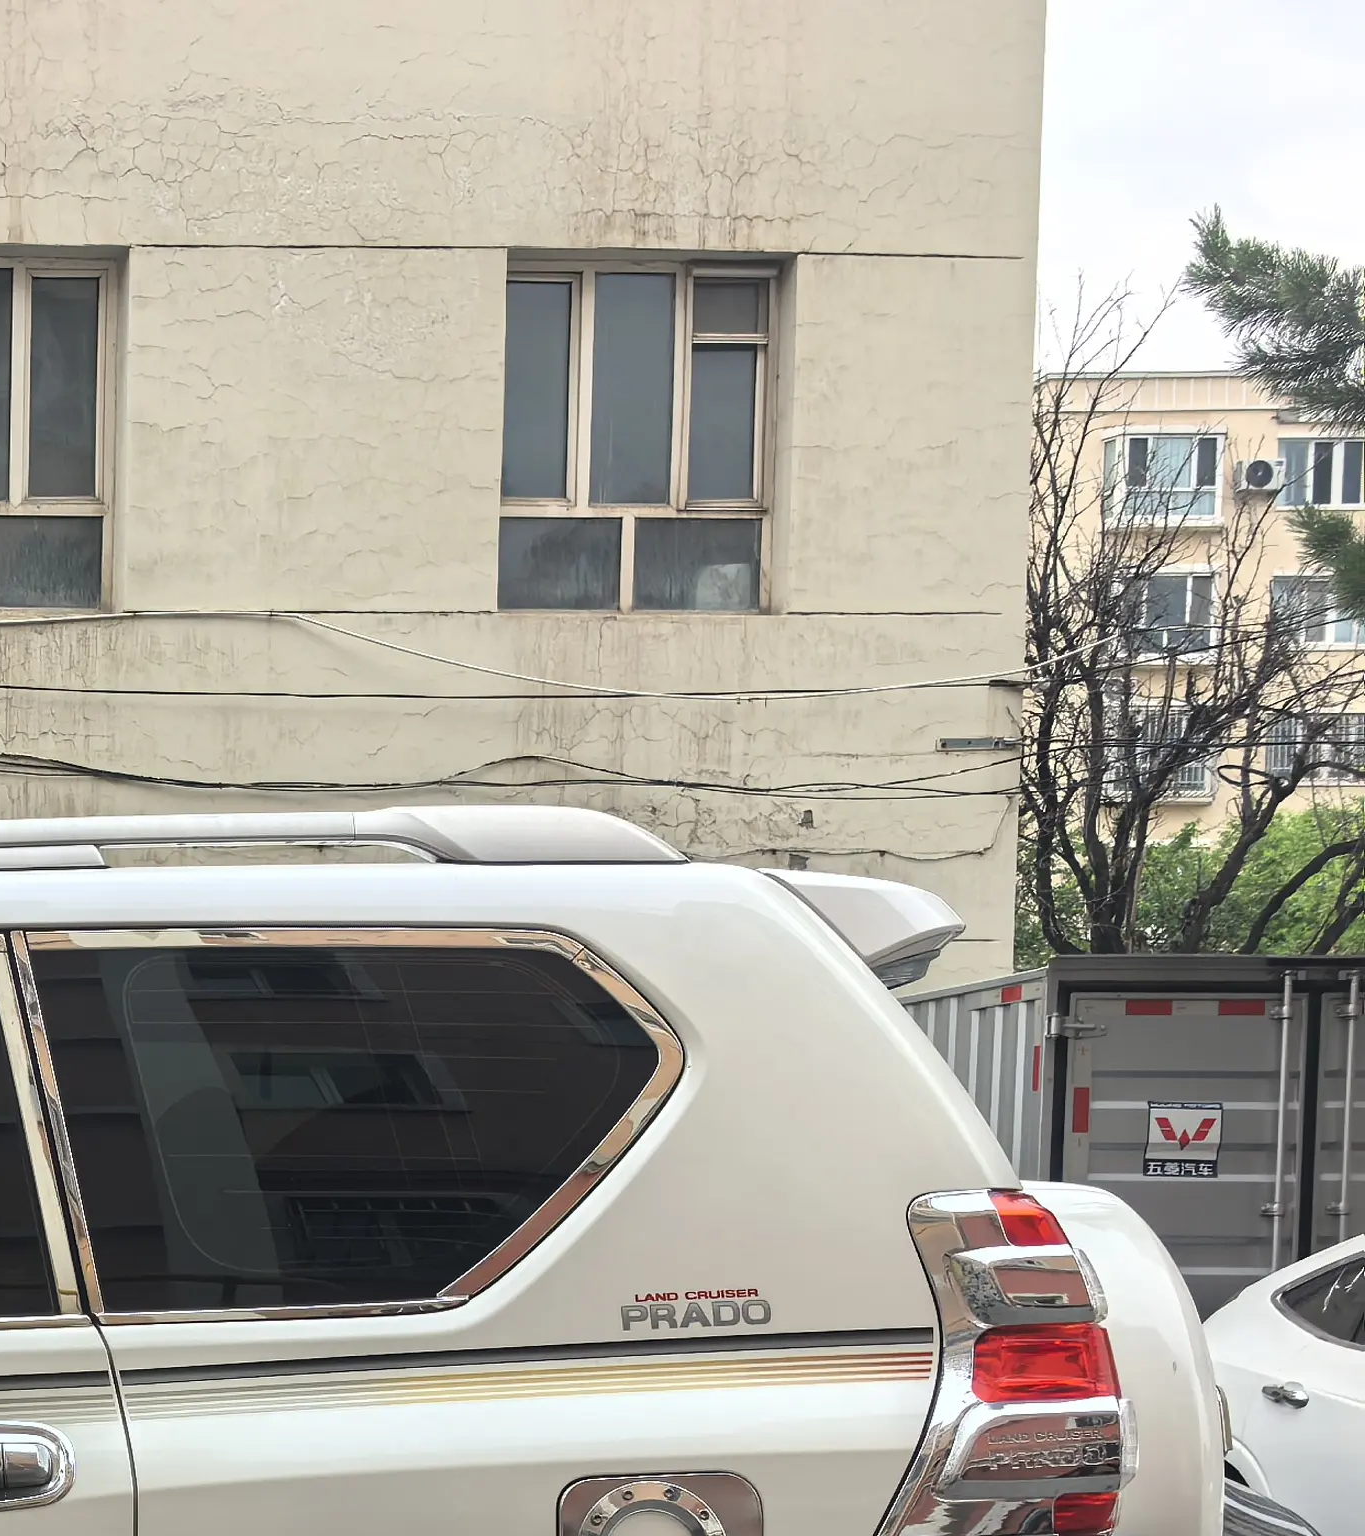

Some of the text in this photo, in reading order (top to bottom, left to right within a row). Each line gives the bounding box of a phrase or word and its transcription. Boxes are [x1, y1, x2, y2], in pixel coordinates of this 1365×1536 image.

[1146, 1162, 1214, 1176] 五菱汽车
[635, 1288, 759, 1303] LAND CRUISER
[620, 1299, 772, 1331] PRADO
